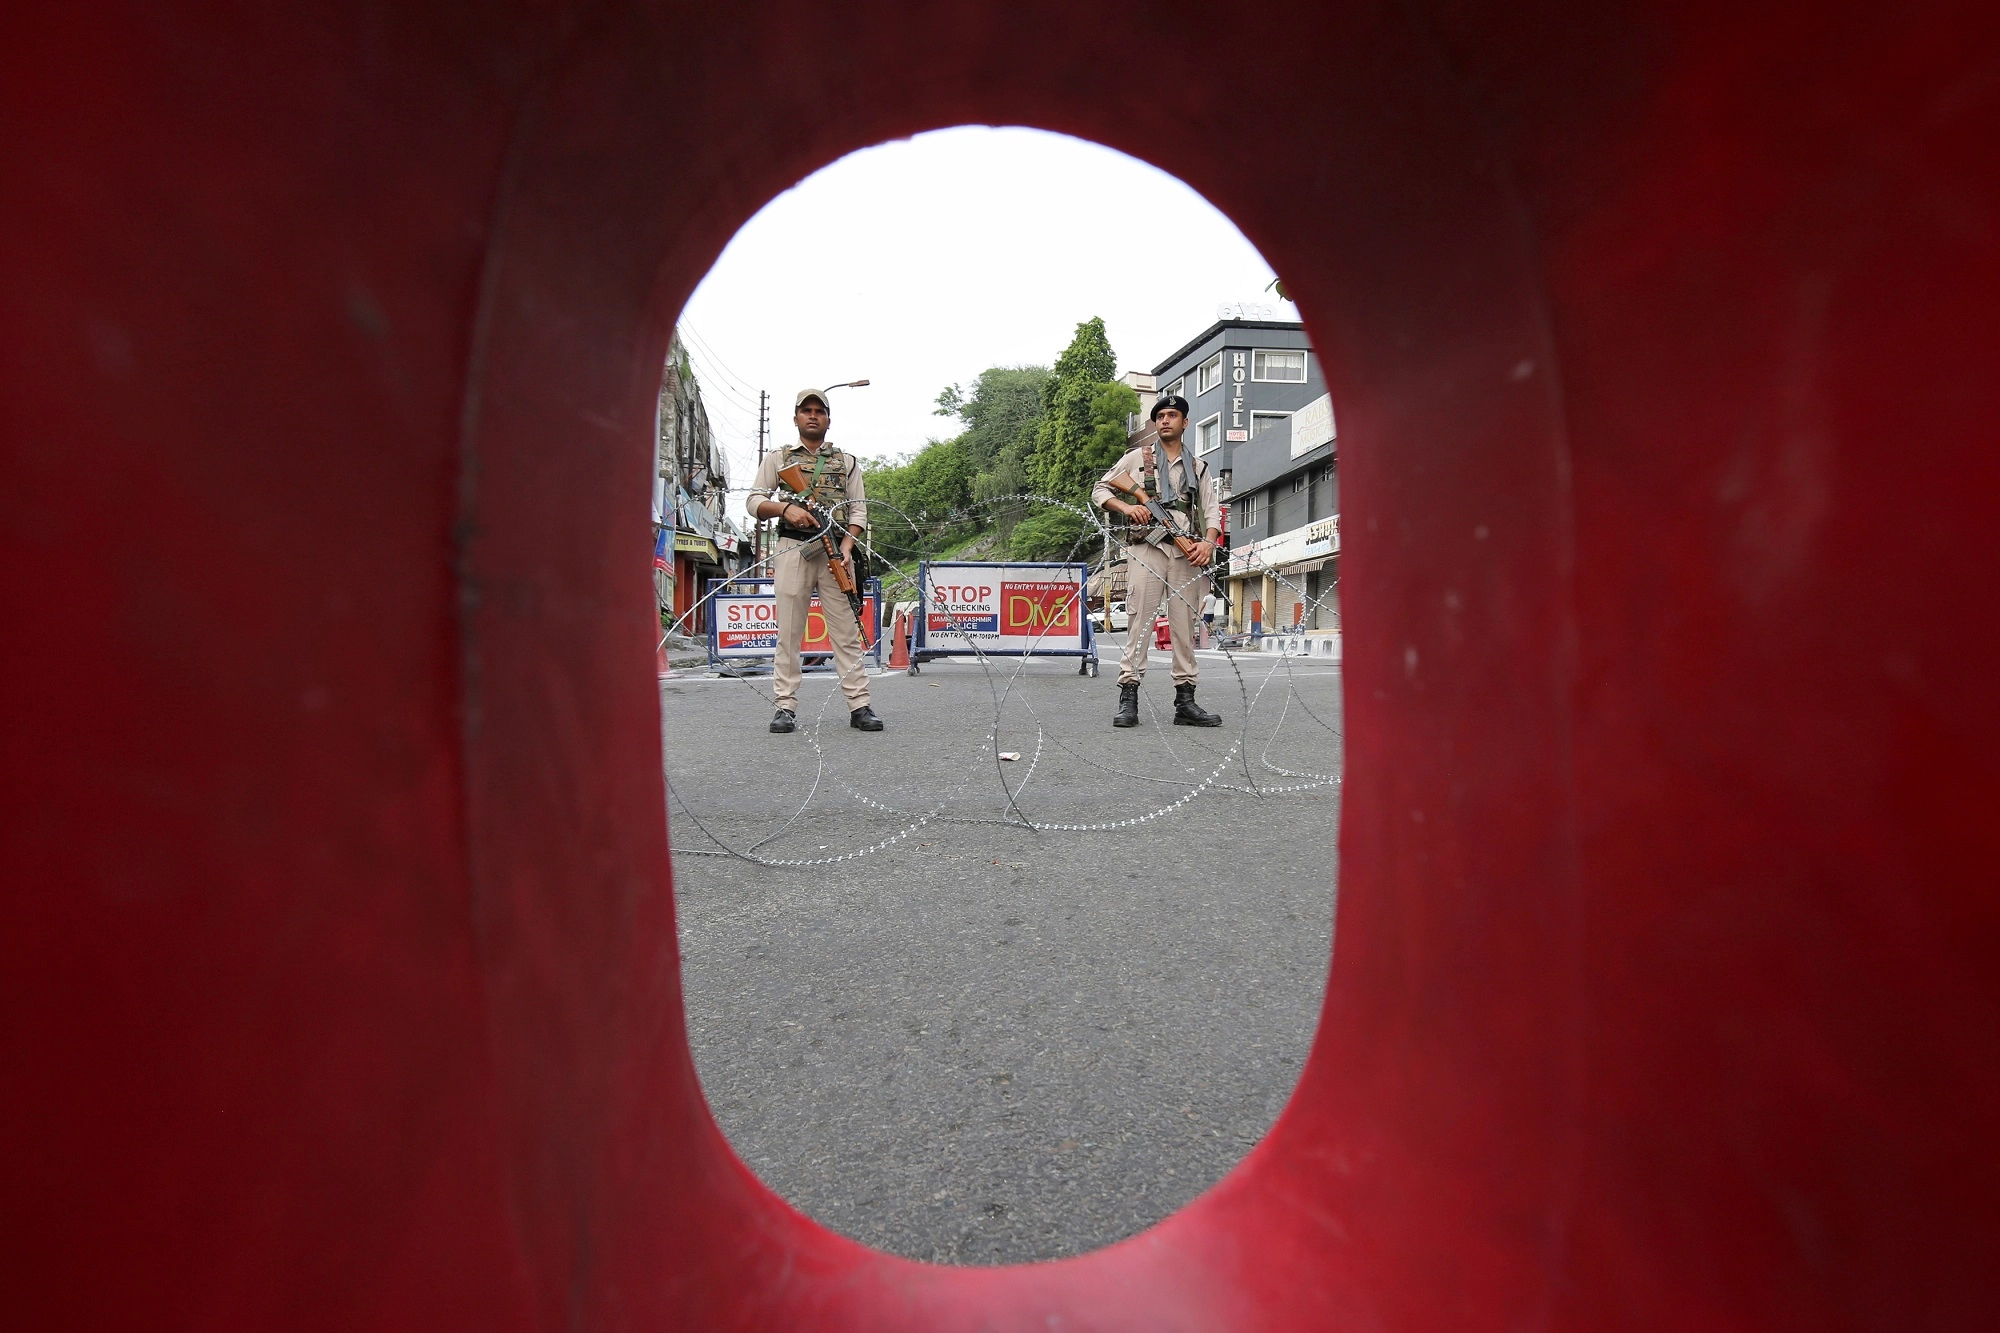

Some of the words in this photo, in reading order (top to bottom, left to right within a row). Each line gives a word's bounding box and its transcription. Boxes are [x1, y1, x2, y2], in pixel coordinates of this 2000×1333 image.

[1232, 352, 1246, 428] HOTEL
[934, 585, 992, 603] STOP
[726, 633, 750, 641] JAMMU
[742, 640, 771, 648] POLICE
